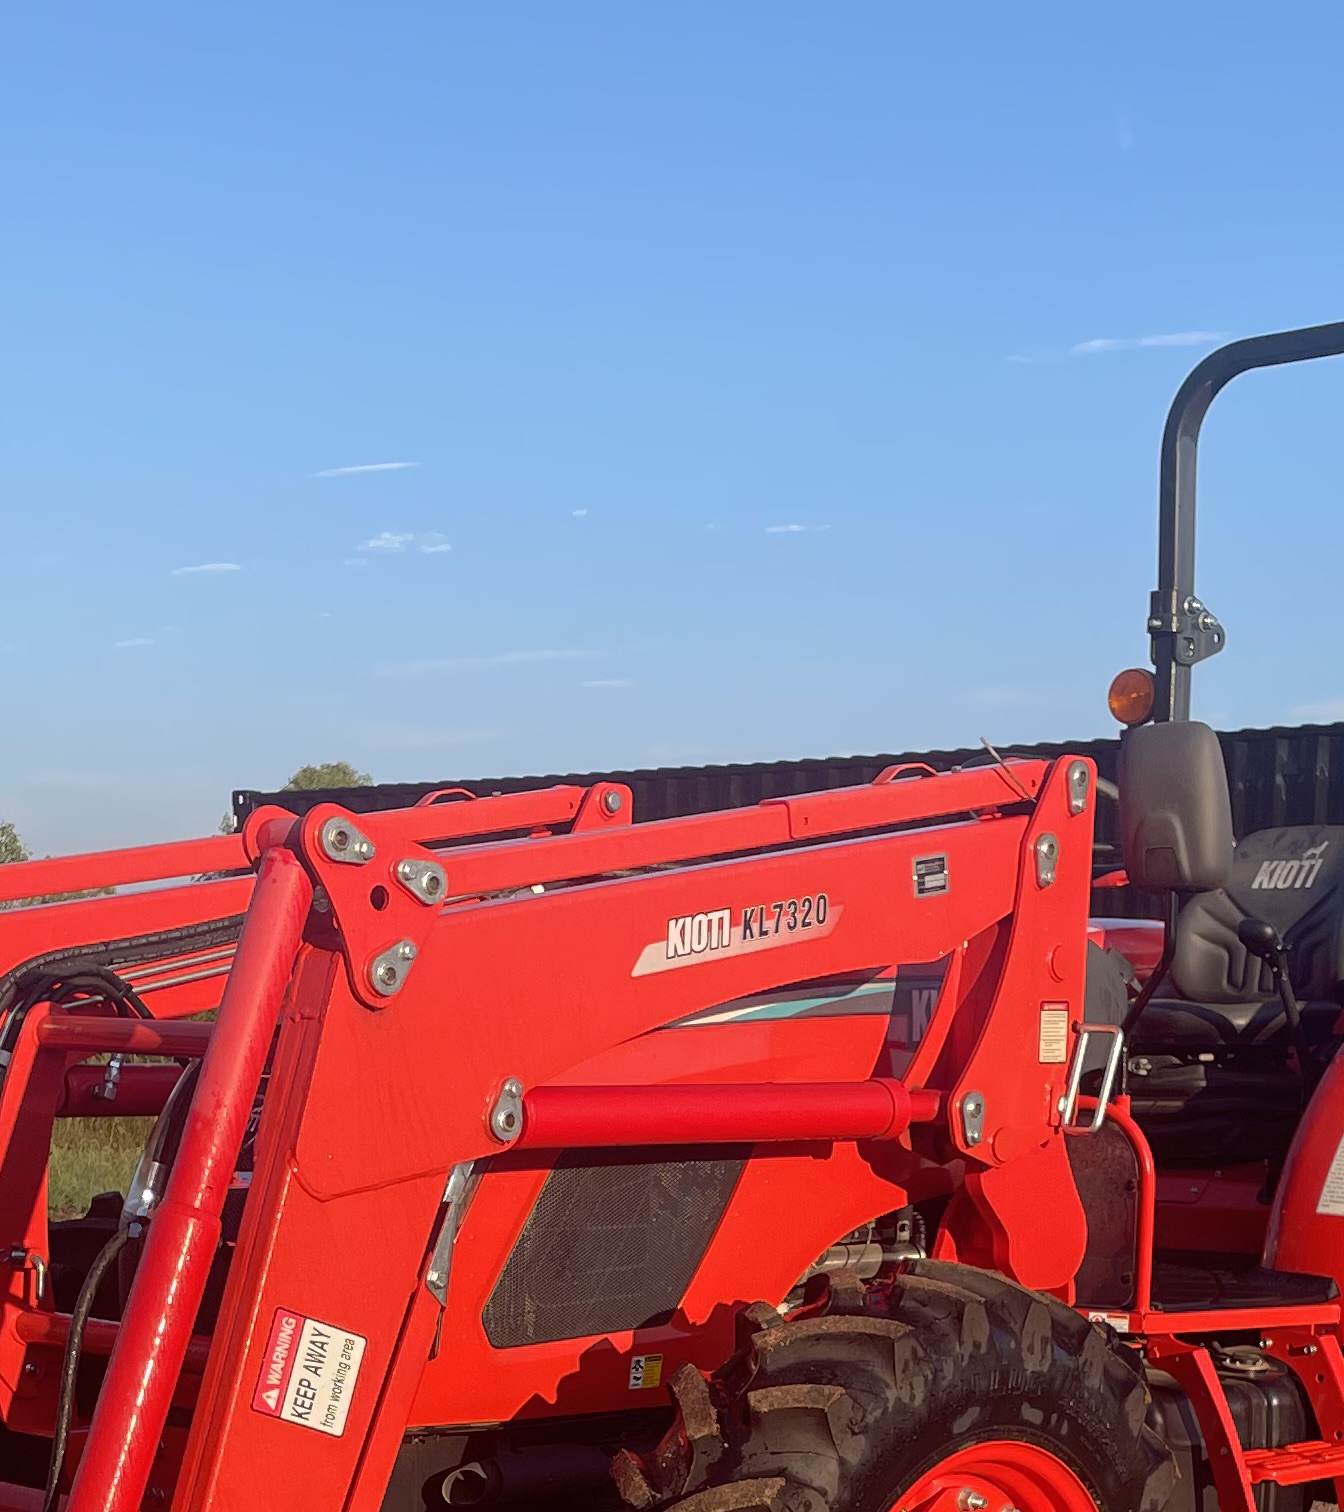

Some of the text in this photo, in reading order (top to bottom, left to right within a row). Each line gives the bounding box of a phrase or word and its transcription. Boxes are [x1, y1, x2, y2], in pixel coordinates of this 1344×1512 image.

[1251, 859, 1323, 889] KIOTI
[666, 893, 828, 958] KIOTI KL7320
[266, 1316, 296, 1385] WARNING
[290, 1327, 331, 1421] KEEP AWAY
[320, 1338, 355, 1428] from working area
